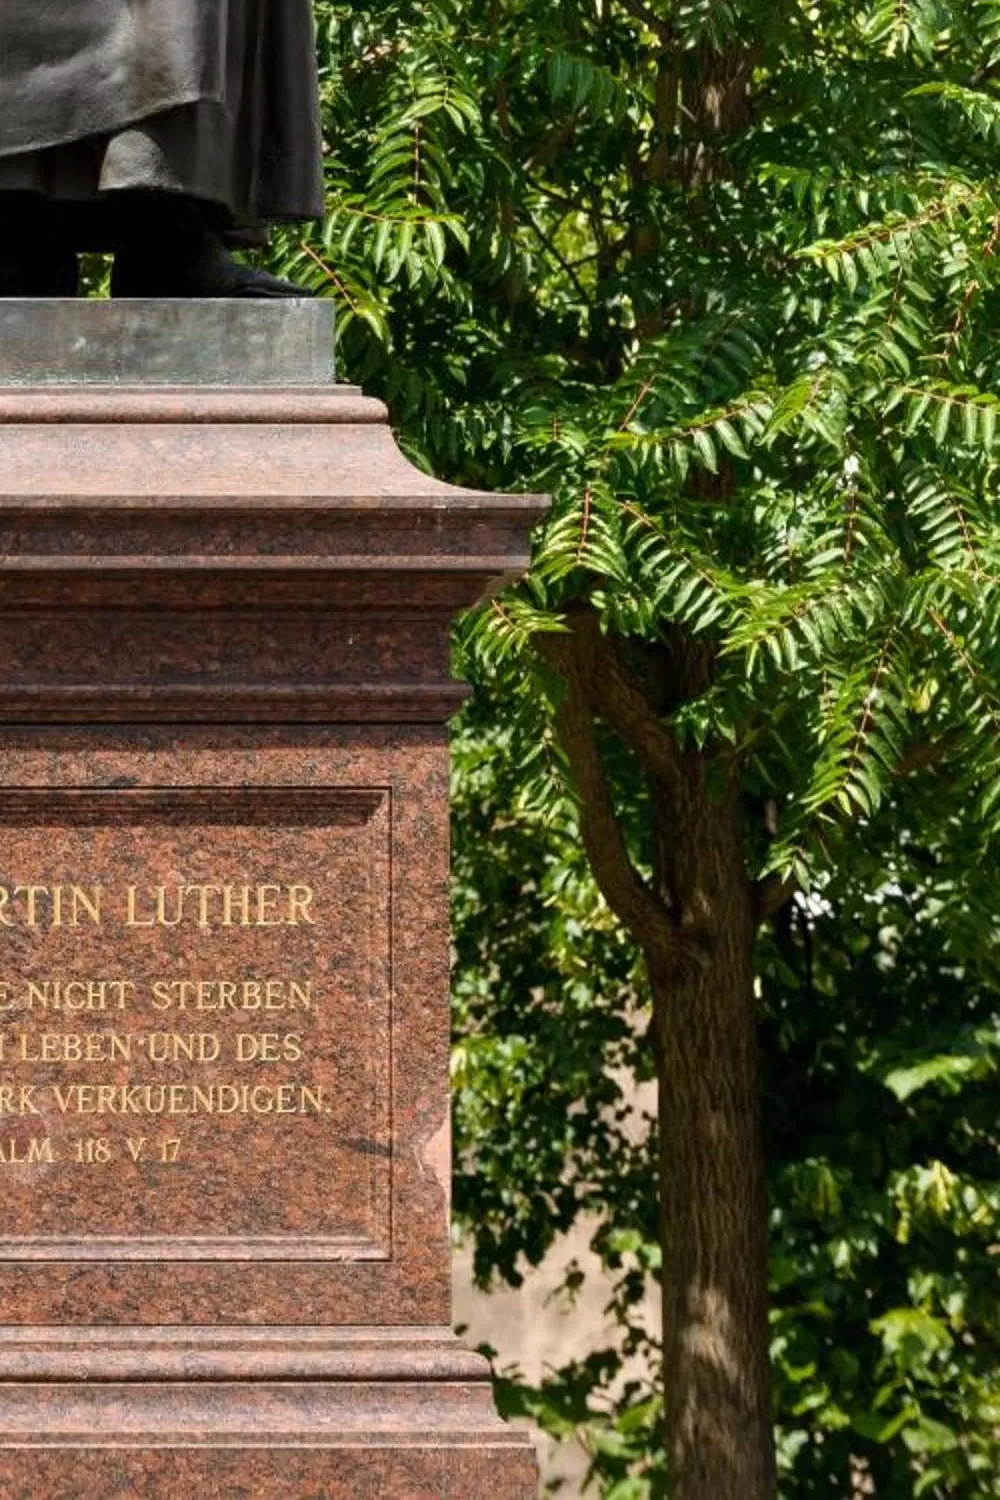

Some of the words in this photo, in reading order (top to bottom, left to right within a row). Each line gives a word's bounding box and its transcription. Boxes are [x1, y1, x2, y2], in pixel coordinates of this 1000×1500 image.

[125, 884, 317, 926] LUTHER
[27, 981, 135, 1010] NICHT
[151, 981, 312, 1010] STERBEN
[20, 1033, 133, 1062] LEBEN
[148, 1033, 221, 1062] UND
[235, 1033, 302, 1062] DES
[52, 1085, 332, 1114] VERKUENDIGEN.
[75, 1137, 111, 1163] 118
[160, 1139, 182, 1162] 17
